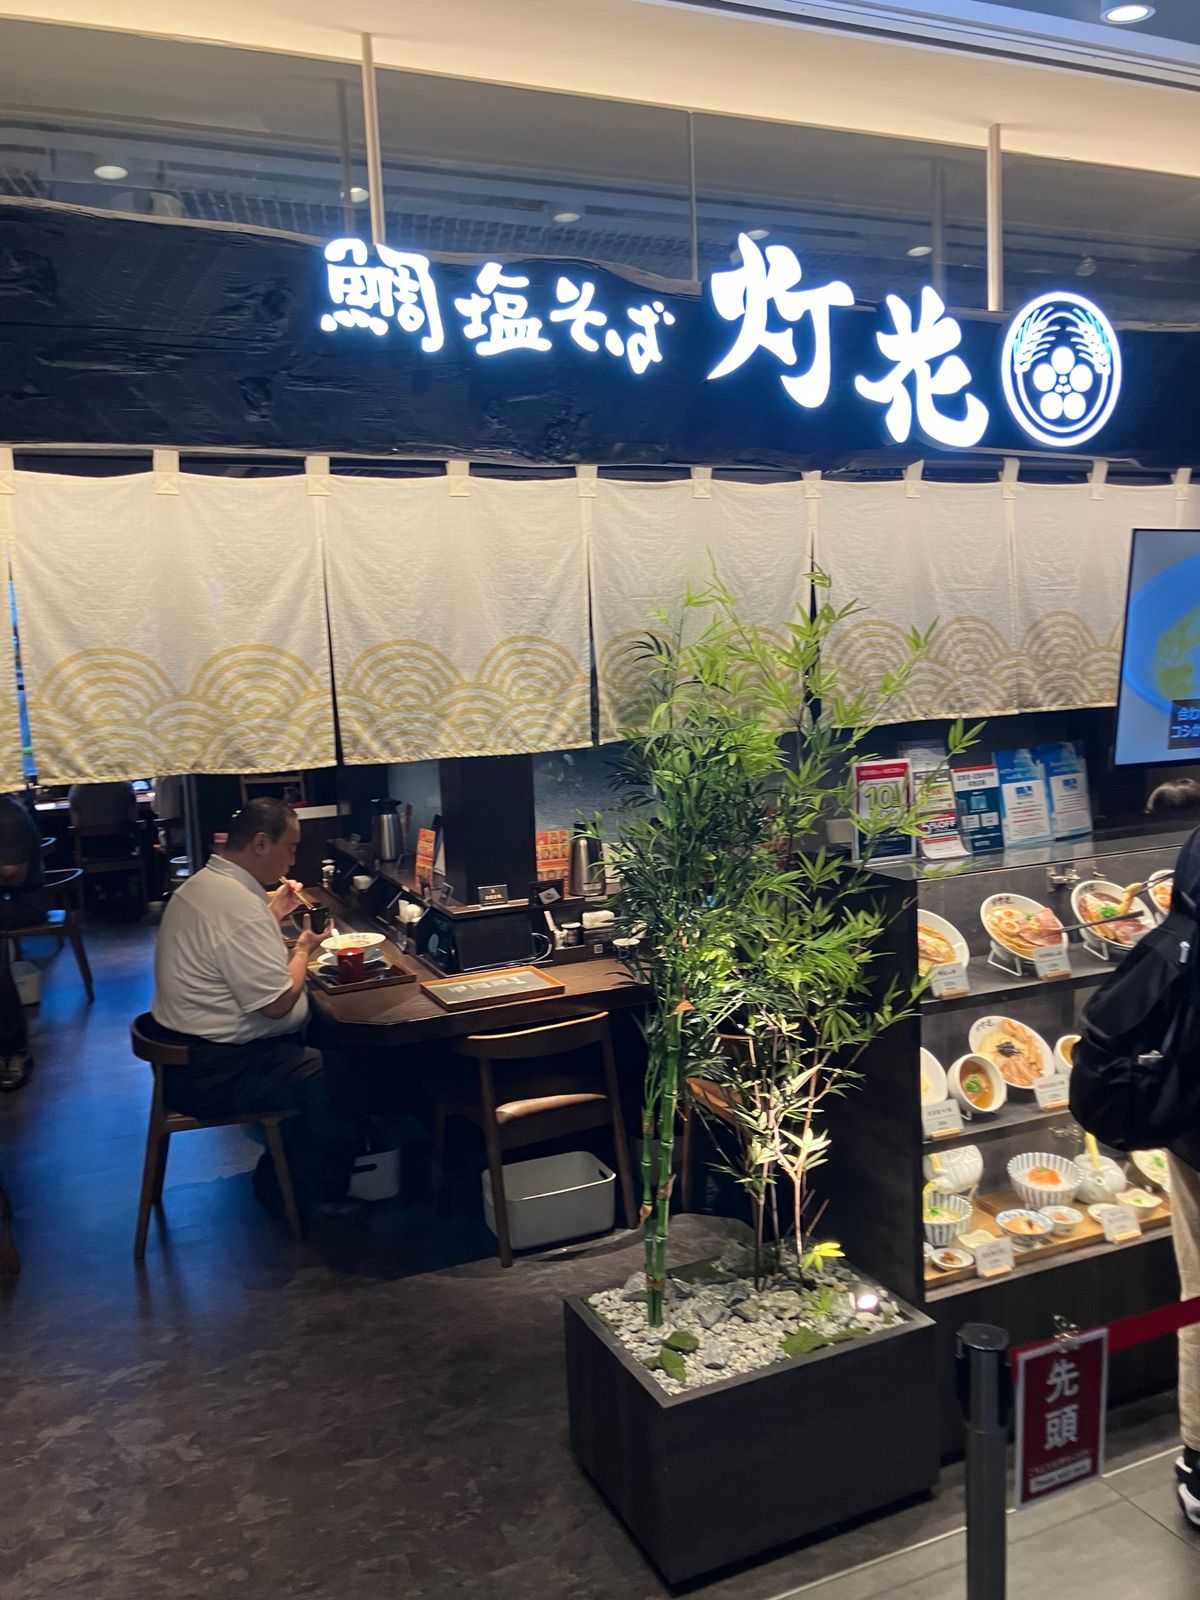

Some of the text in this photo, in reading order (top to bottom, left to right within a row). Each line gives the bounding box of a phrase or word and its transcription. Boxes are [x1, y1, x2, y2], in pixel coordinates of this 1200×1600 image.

[320, 232, 990, 448] 鯛塩そば 灯花
[1044, 1358, 1080, 1450] 先頭
